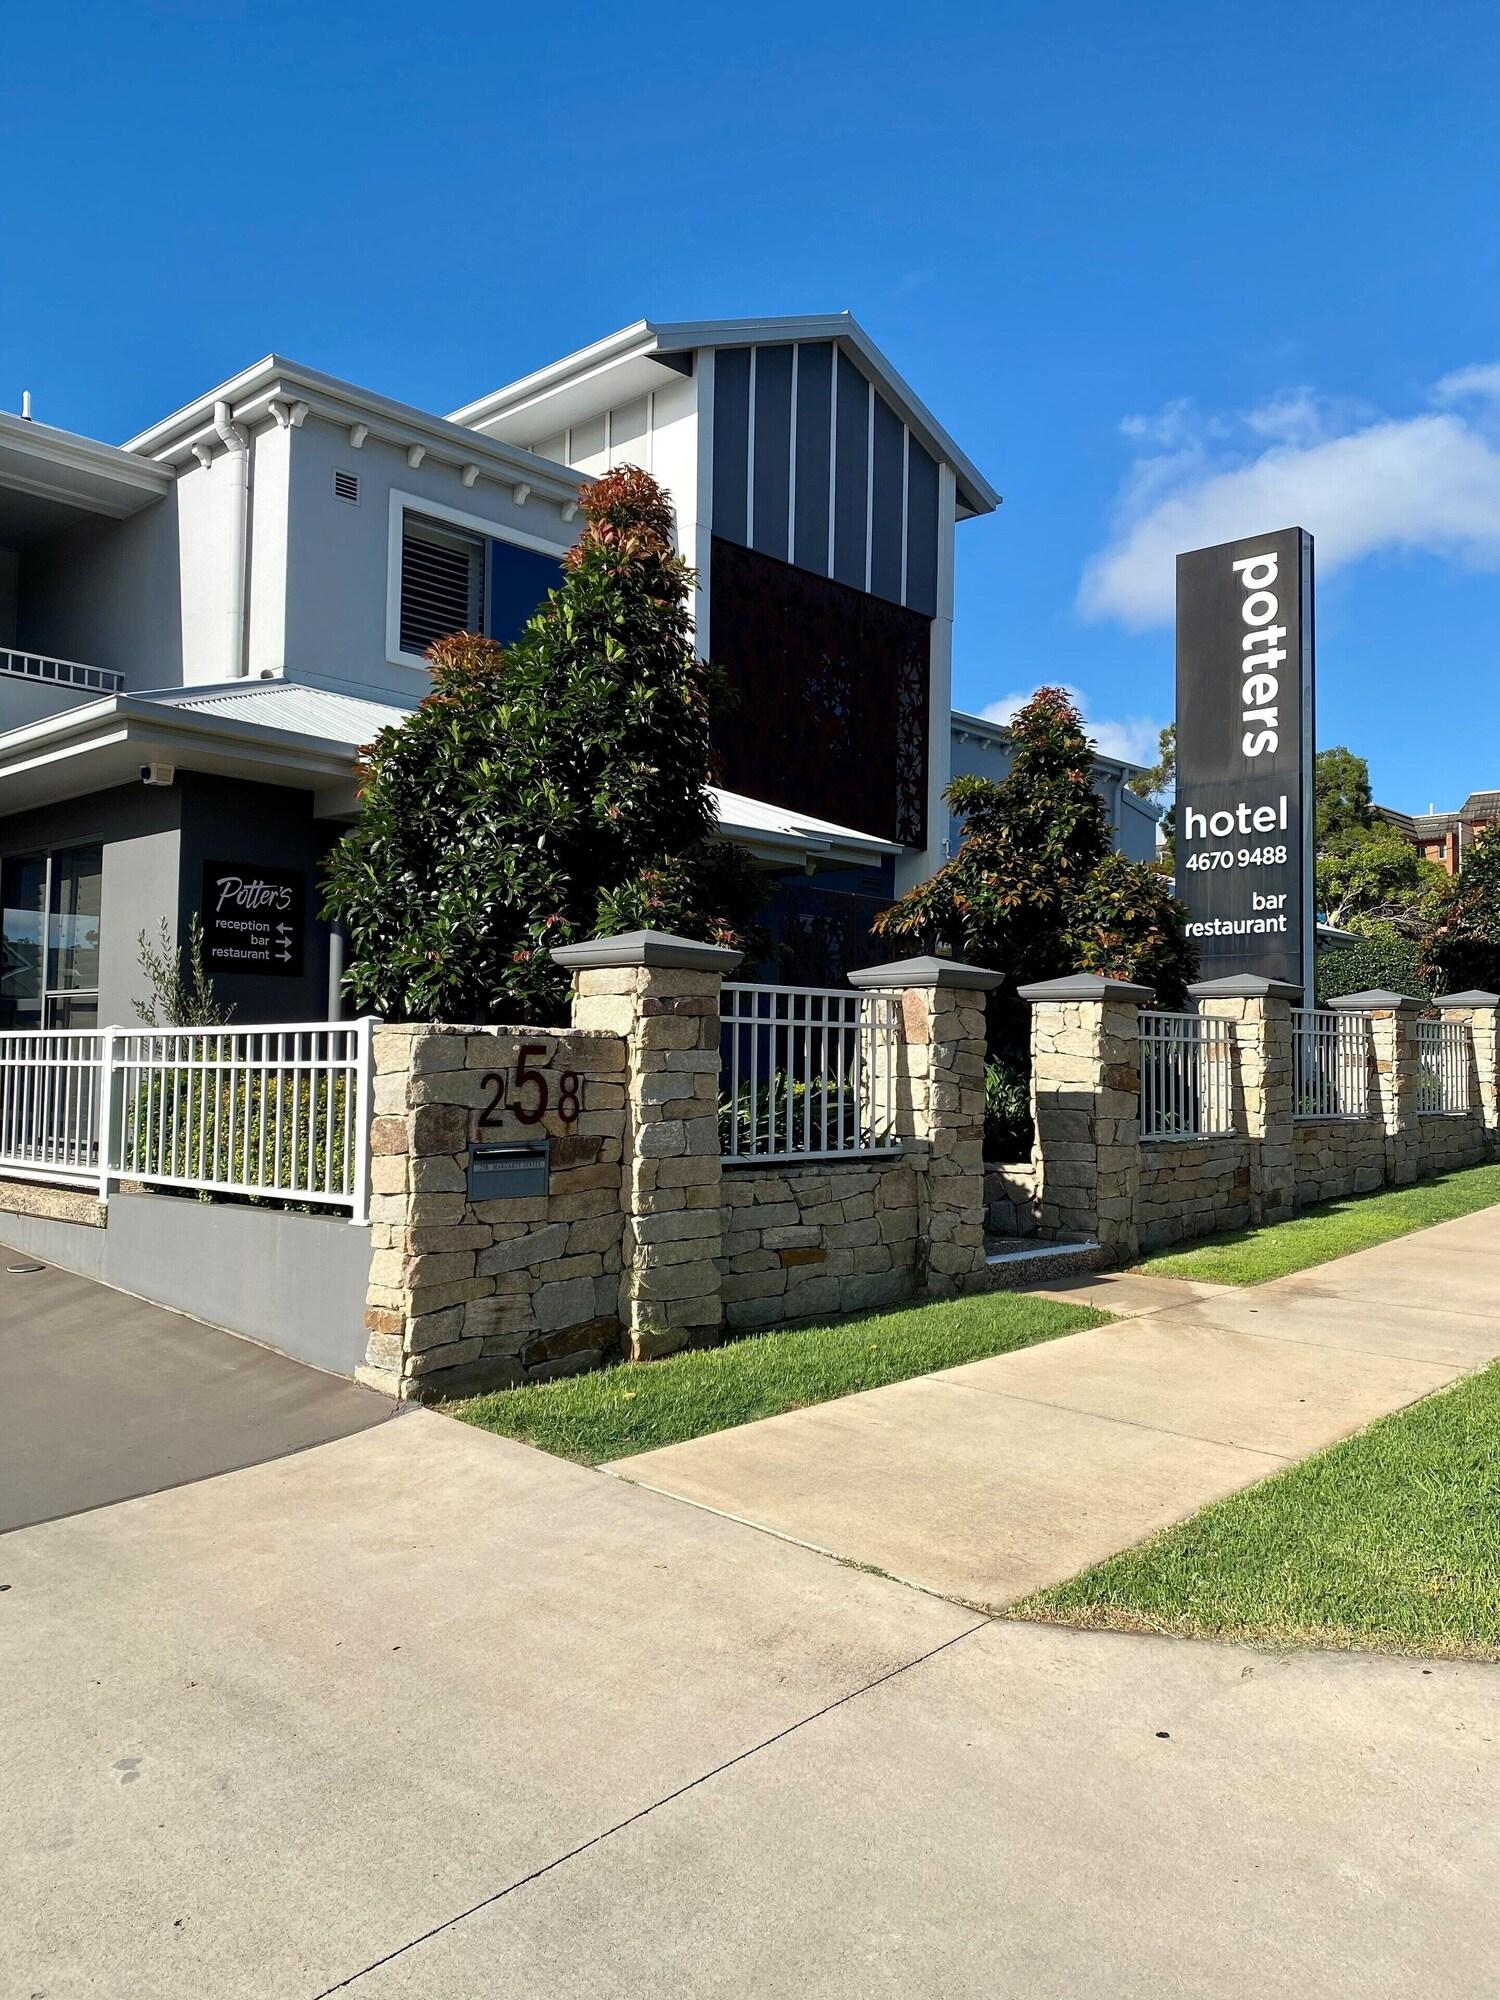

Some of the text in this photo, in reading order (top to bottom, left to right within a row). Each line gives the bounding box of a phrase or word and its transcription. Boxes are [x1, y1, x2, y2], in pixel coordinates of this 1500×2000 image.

[1232, 551, 1287, 758] potters
[1185, 795, 1288, 840] hotel
[1185, 845, 1288, 872] 4670 9488
[1252, 891, 1287, 911] bar
[215, 919, 270, 932] reception
[1185, 914, 1287, 937] restaurant
[250, 934, 270, 946] bar
[212, 947, 270, 960] restaurant
[478, 1045, 580, 1127] 258
